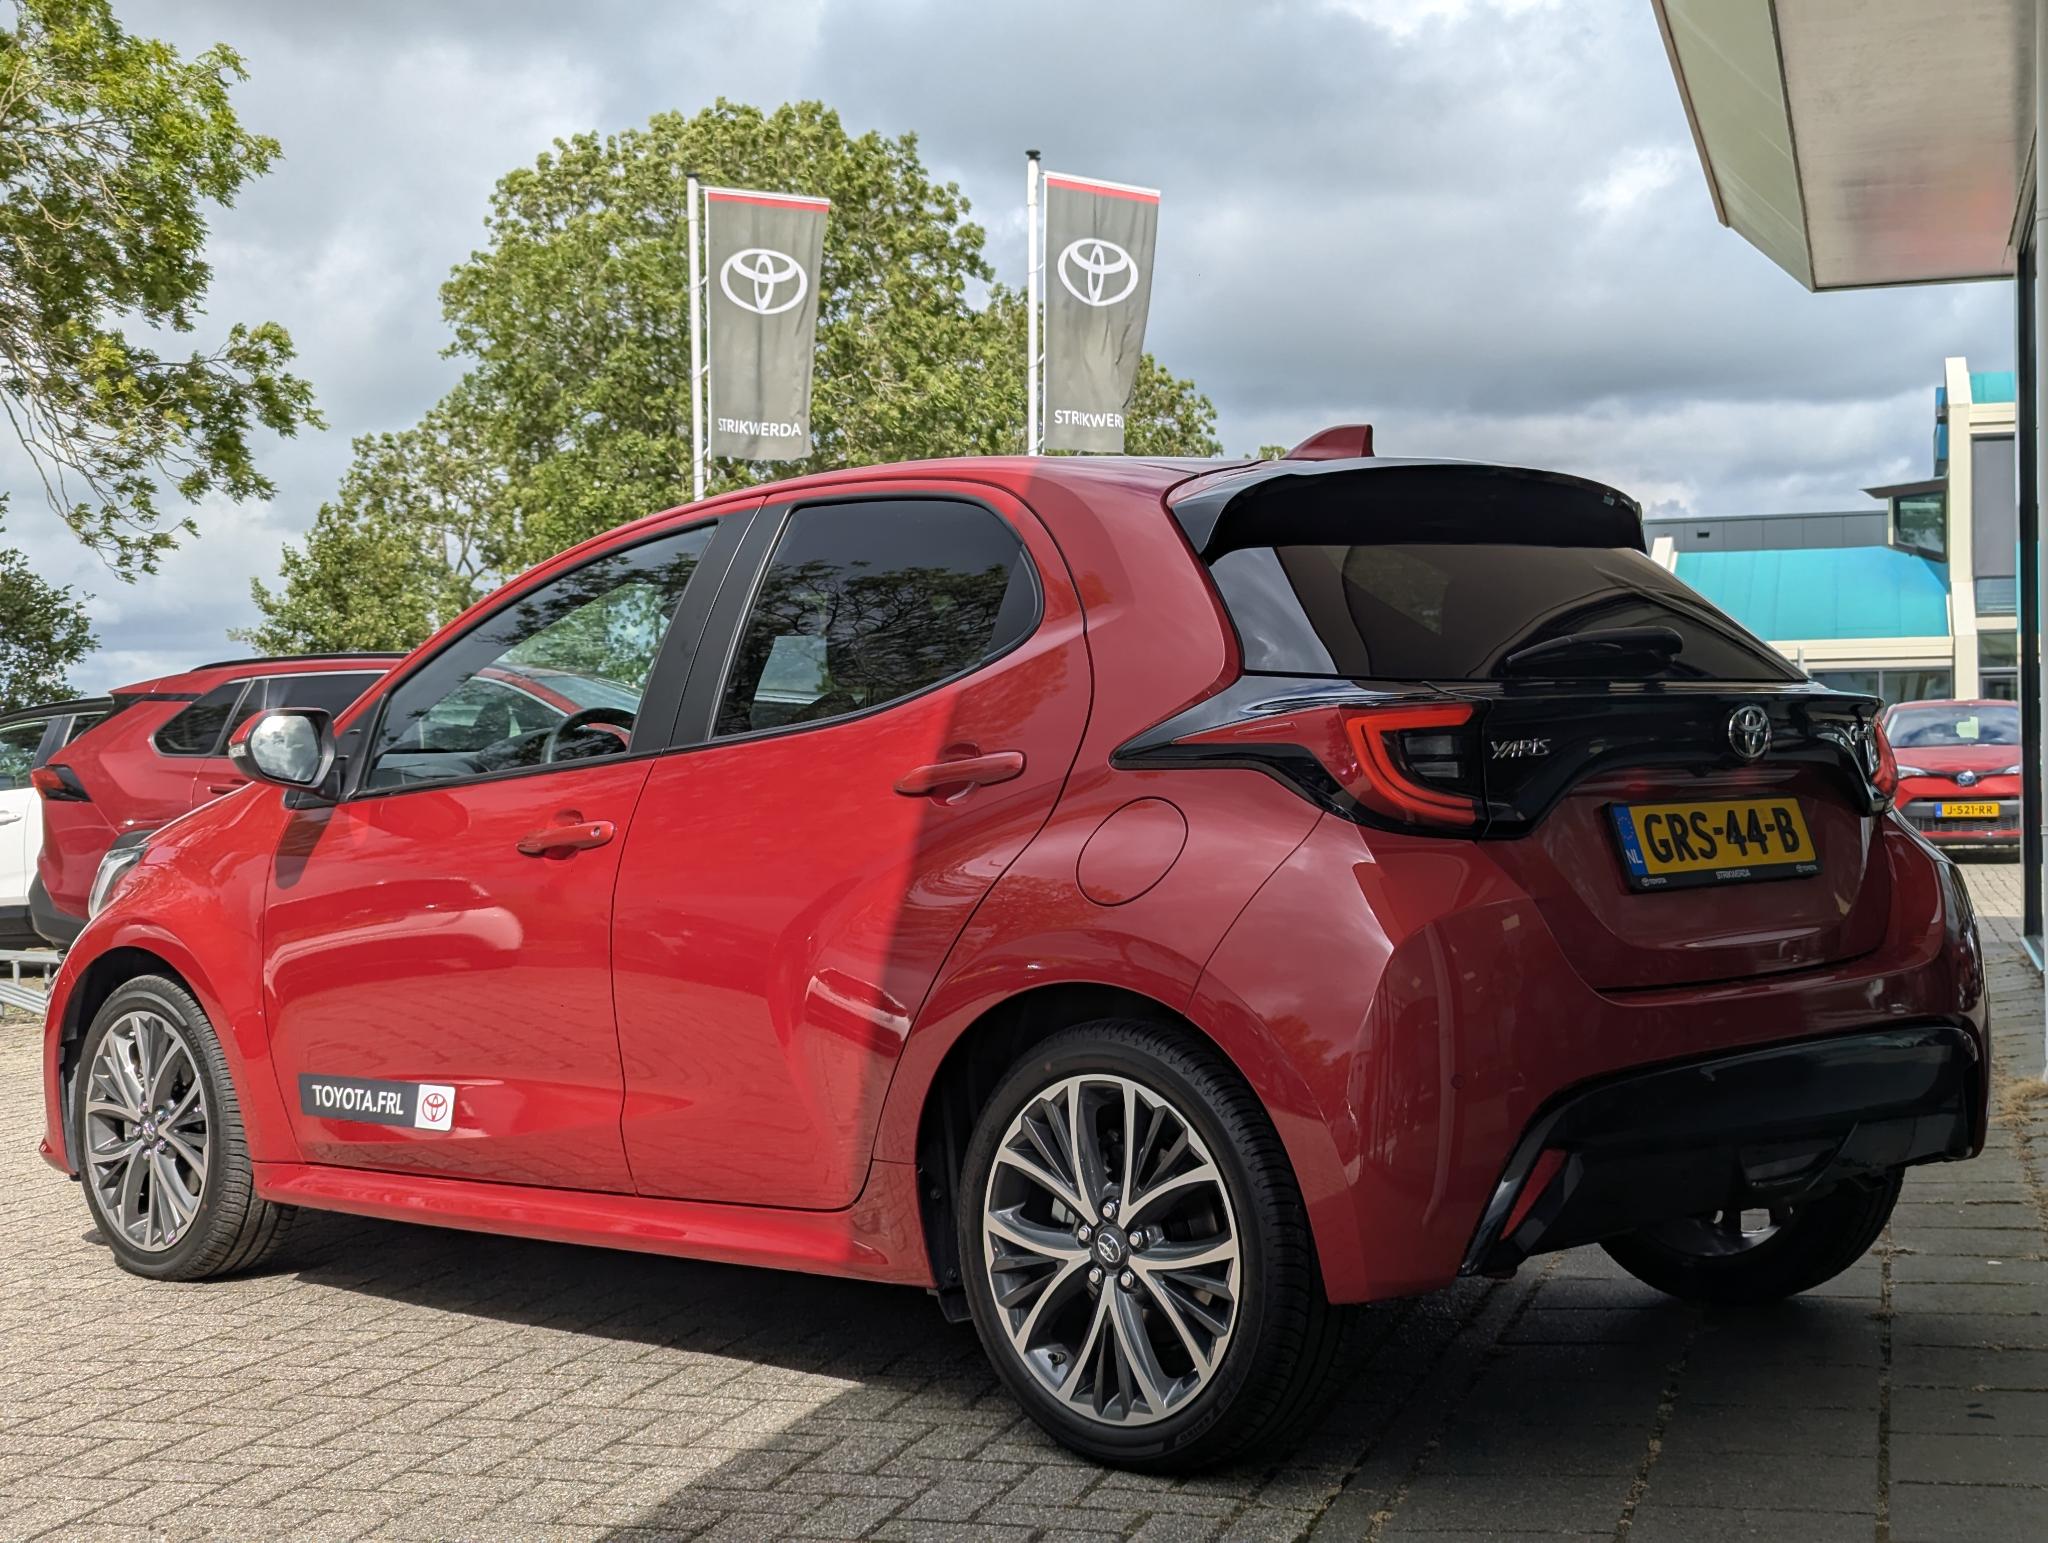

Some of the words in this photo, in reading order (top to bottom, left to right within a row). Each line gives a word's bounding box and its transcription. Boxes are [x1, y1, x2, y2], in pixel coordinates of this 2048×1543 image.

[718, 417, 802, 437] STRIKWERDA
[1491, 738, 1551, 760] YARIS
[1643, 807, 1800, 864] GRS-44-B
[1625, 848, 1643, 865] NL
[311, 1084, 404, 1115] TOYOTA.FRL
